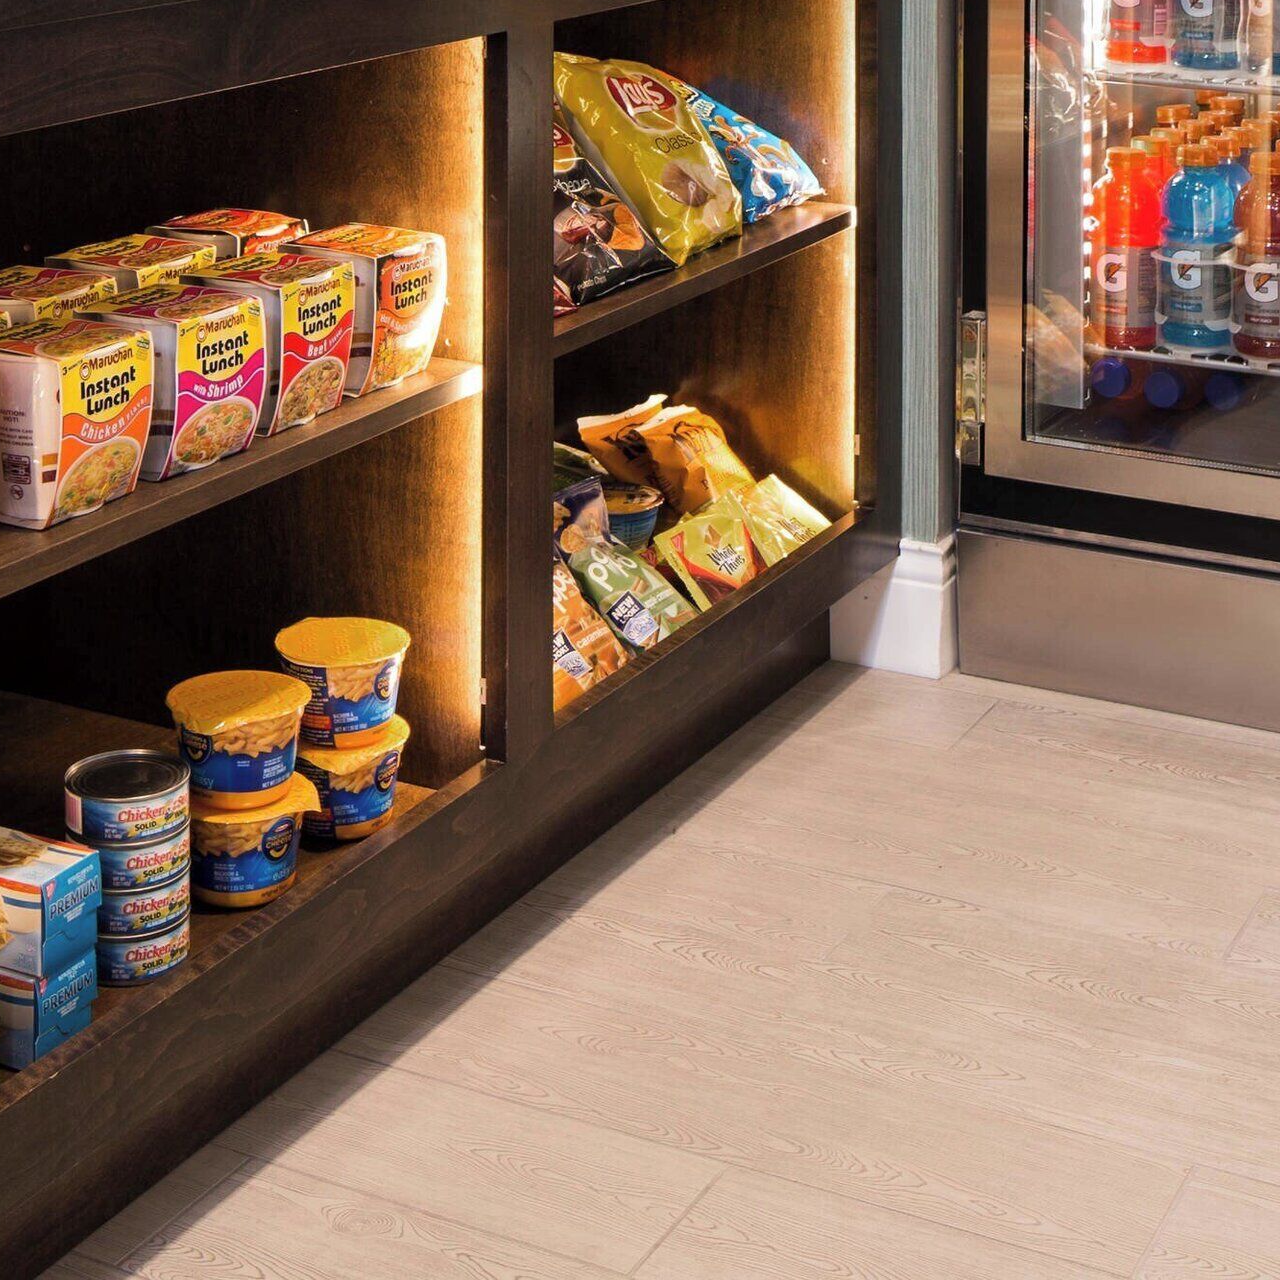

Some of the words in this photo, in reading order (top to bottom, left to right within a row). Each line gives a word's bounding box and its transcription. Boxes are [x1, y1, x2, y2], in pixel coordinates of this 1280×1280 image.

[1097, 253, 1128, 293] G
[1171, 250, 1202, 290] G
[306, 279, 342, 299] Maruchan
[391, 271, 433, 297] Instant
[1244, 262, 1279, 303] G
[61, 290, 101, 311] Maruchan
[298, 294, 343, 323] Instant
[395, 288, 428, 311] Lunch
[205, 313, 246, 333] Maruchan
[302, 311, 337, 337] Lunch
[196, 330, 249, 360] Instant
[308, 340, 328, 358] Beef
[89, 347, 134, 370] Maruchan
[201, 351, 245, 376] Lunch
[80, 365, 137, 400] Instant
[206, 374, 245, 398] Shrimp
[87, 387, 131, 416] Lunch
[80, 415, 125, 441] Chicken
[706, 543, 739, 568] Wheat
[718, 553, 746, 576] Thins
[611, 595, 635, 619] NEW
[118, 804, 167, 824] Chicken
[134, 820, 158, 833] SOLID
[126, 849, 172, 871] Chicken
[143, 865, 165, 879] SOLID
[49, 875, 100, 919] PREMIUM
[122, 896, 170, 916] Chicken
[139, 911, 162, 925] SOLID
[125, 941, 172, 963] Chicken
[141, 959, 165, 971] SOLID
[42, 968, 94, 1015] PREMIUM
